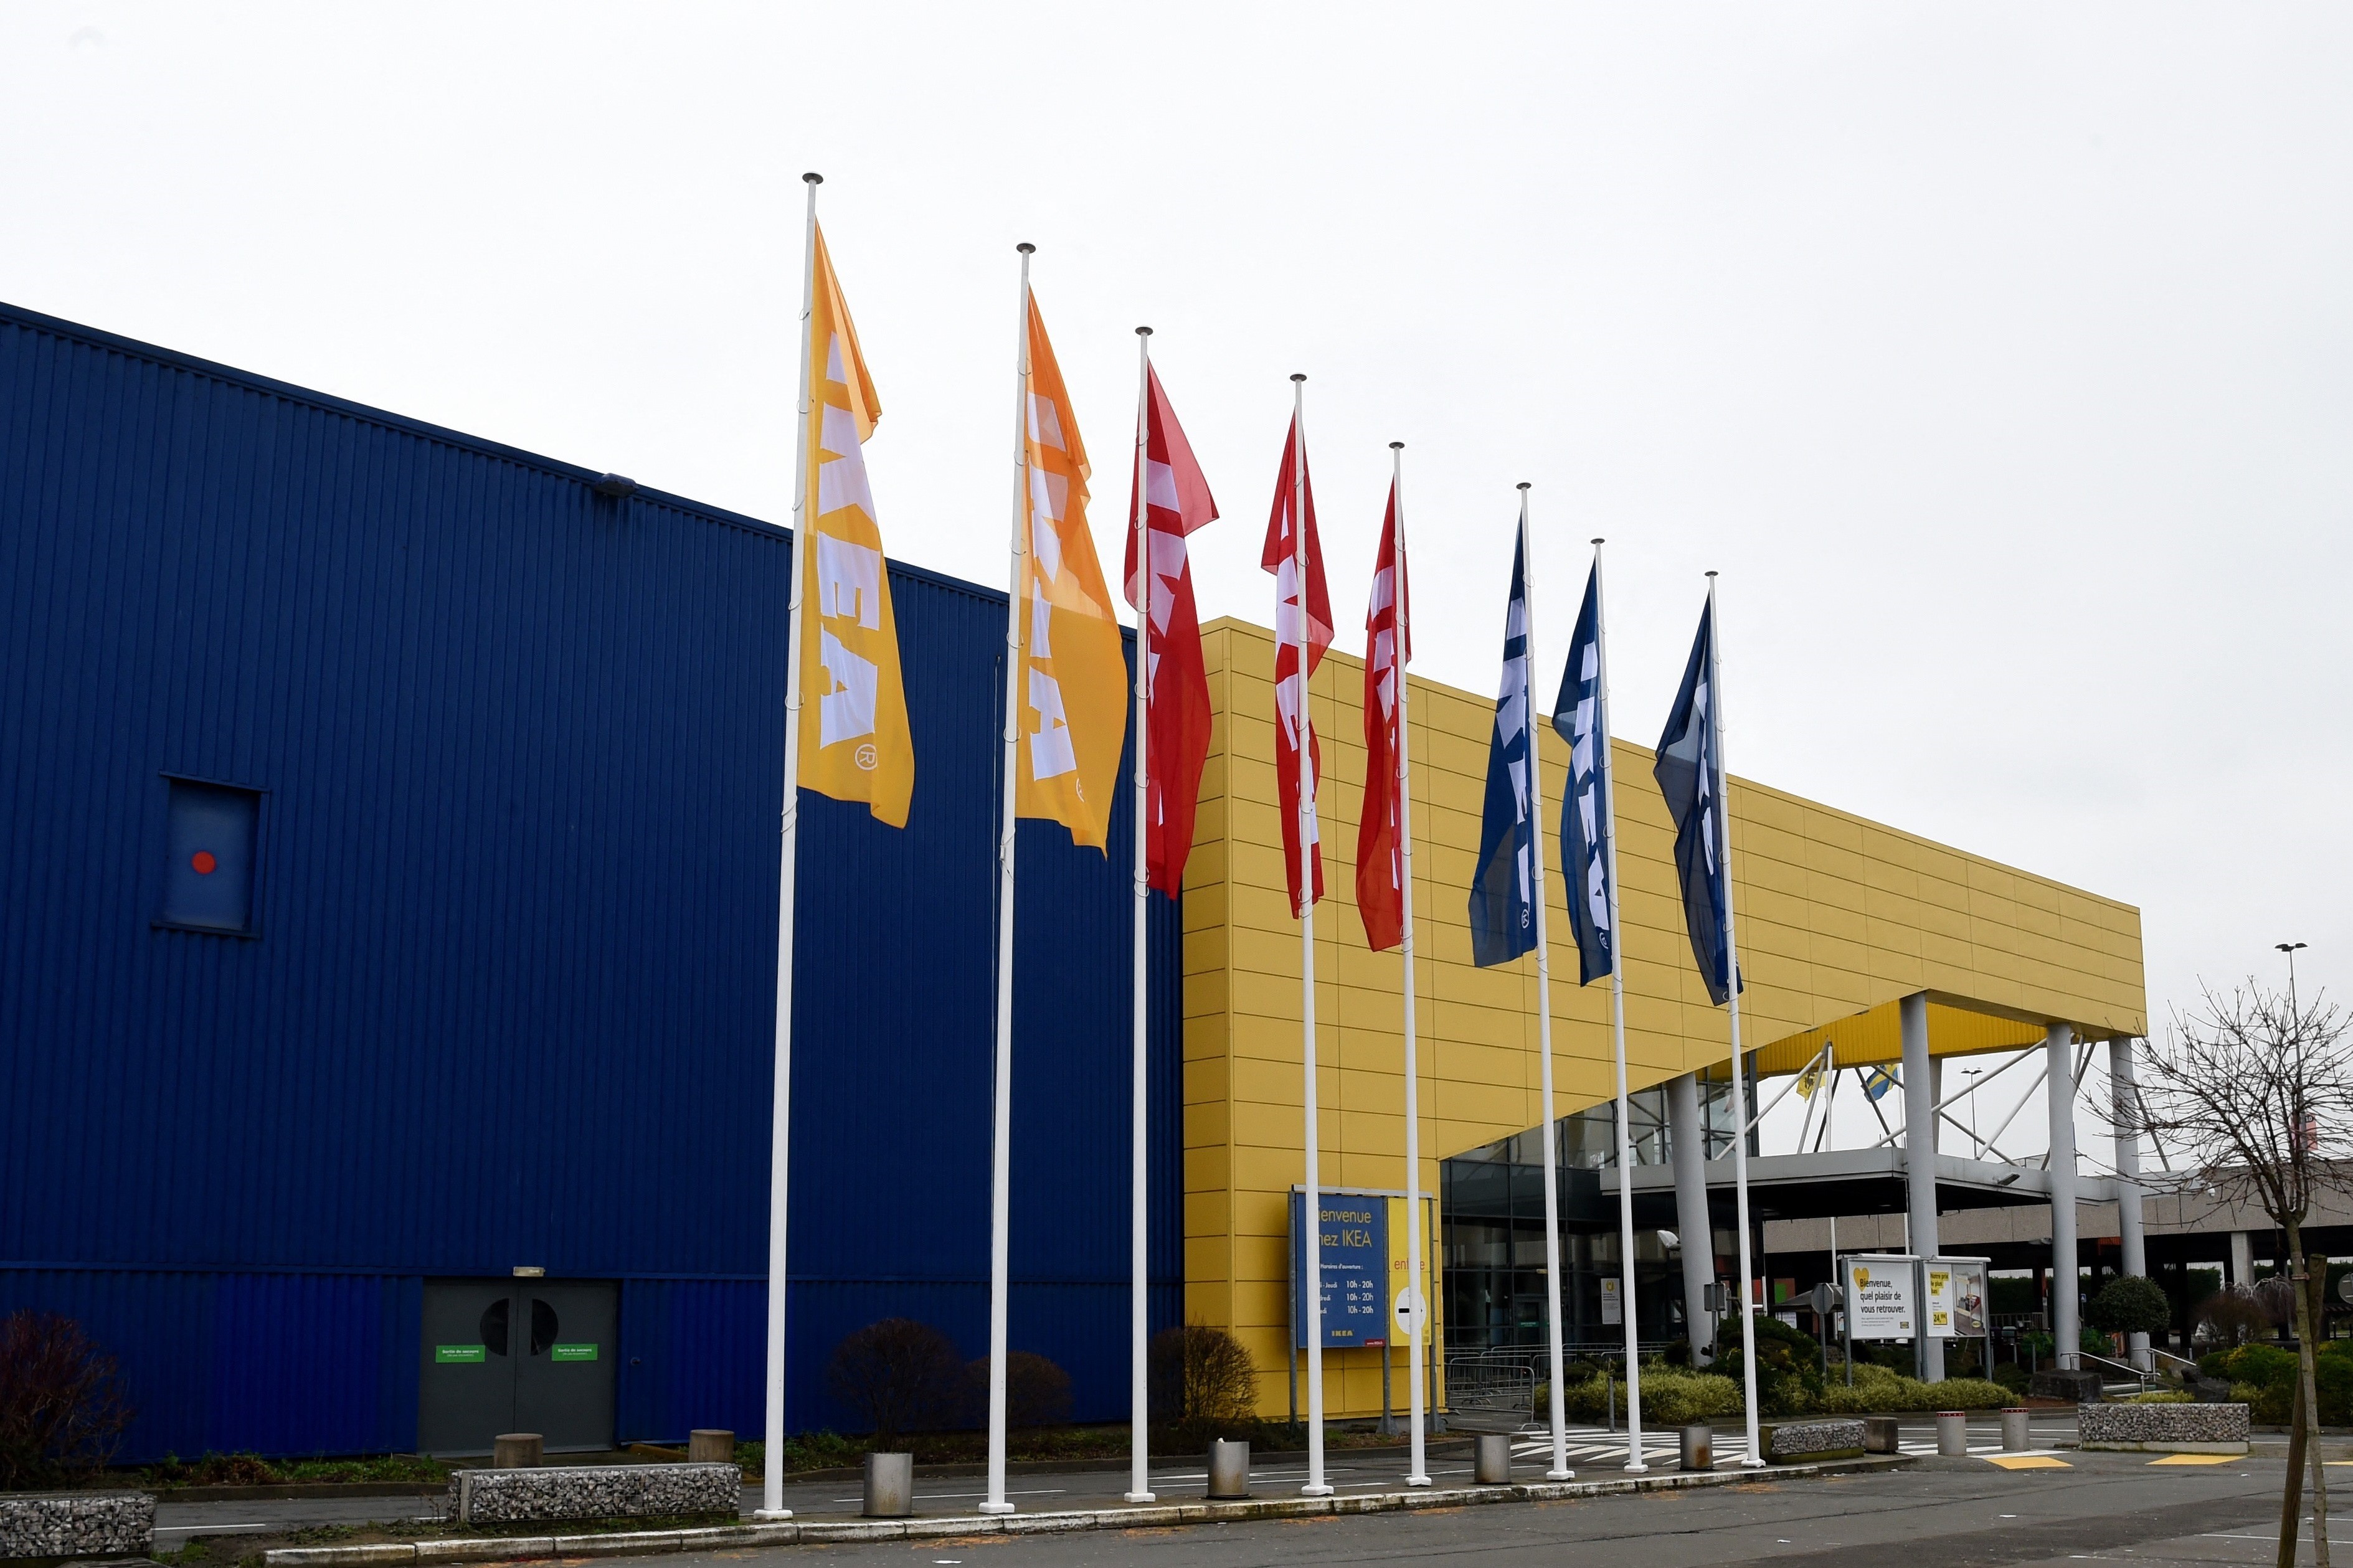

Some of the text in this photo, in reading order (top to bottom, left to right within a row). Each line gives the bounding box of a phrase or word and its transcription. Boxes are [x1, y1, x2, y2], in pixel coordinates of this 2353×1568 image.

[1318, 1204, 1371, 1224] ienvenue
[1342, 1229, 1372, 1247] IKEA
[1394, 1258, 1425, 1270] ente
[1347, 1280, 1358, 1288] 10h
[1362, 1280, 1373, 1288] 20h
[1860, 1278, 1893, 1288] Bienvenue,
[1347, 1293, 1358, 1301] 10h
[1362, 1293, 1374, 1301] 20h
[1860, 1291, 1901, 1303] quel plaisir de
[1348, 1305, 1358, 1314] 10h
[1362, 1305, 1374, 1314] 20h
[1876, 1305, 1906, 1313] retrouver.
